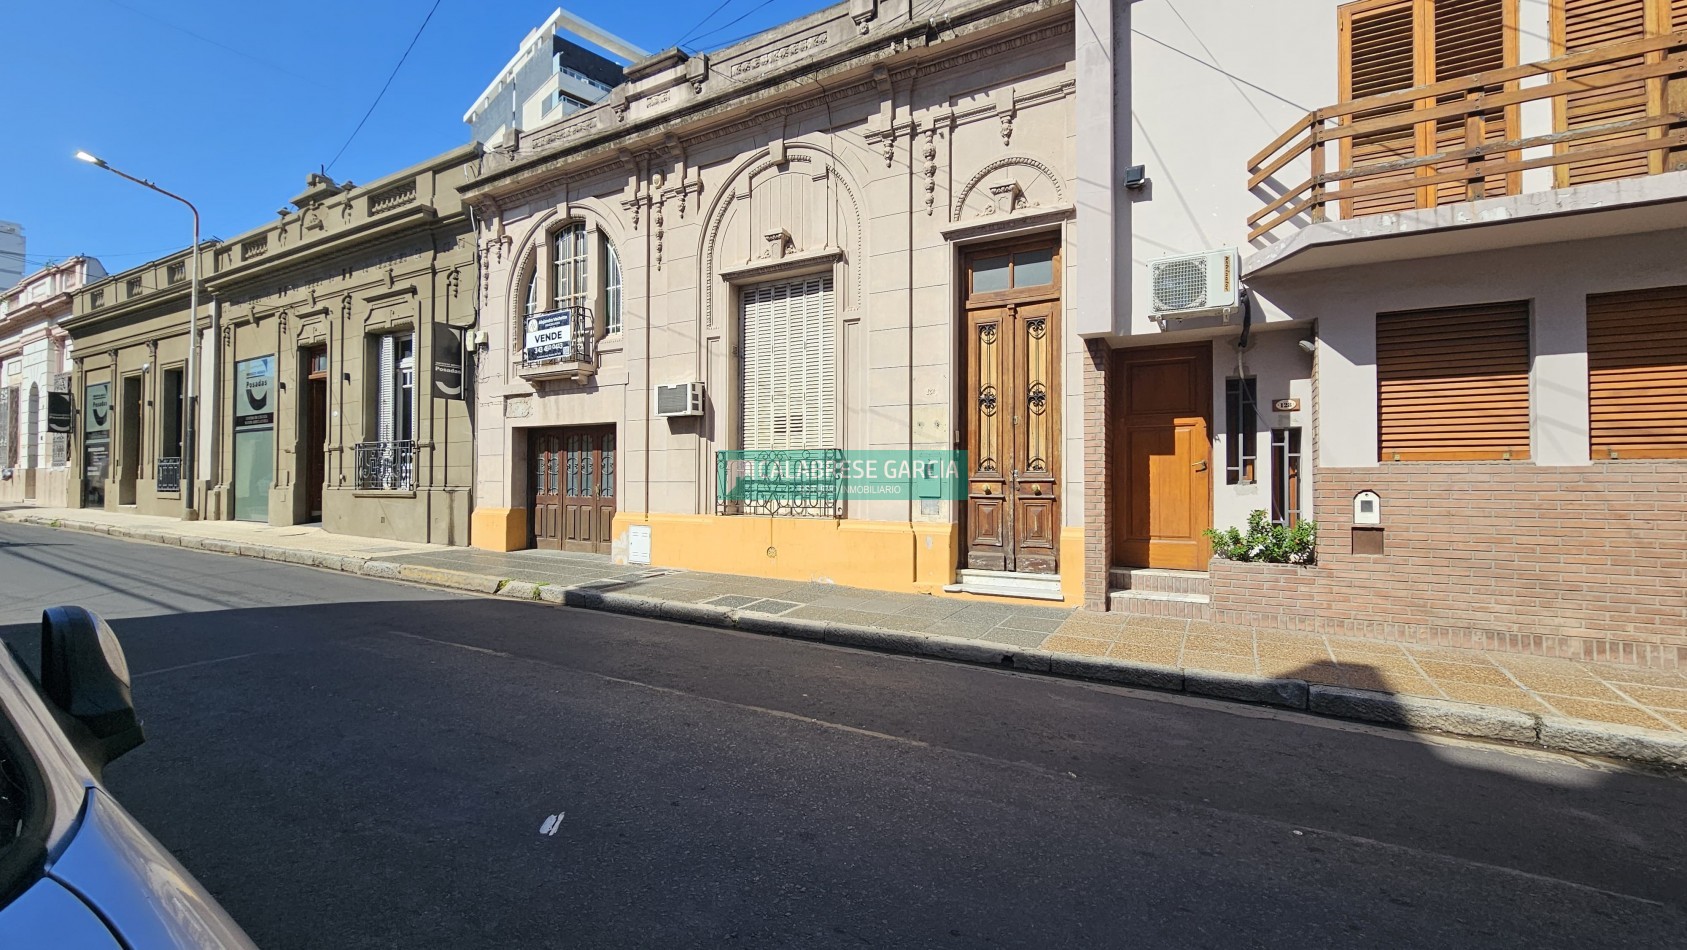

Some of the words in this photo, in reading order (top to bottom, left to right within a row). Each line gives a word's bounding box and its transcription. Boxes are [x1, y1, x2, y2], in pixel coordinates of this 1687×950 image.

[534, 330, 563, 343] VENDE
[435, 366, 461, 374] Posadas
[246, 379, 267, 388] Posadas
